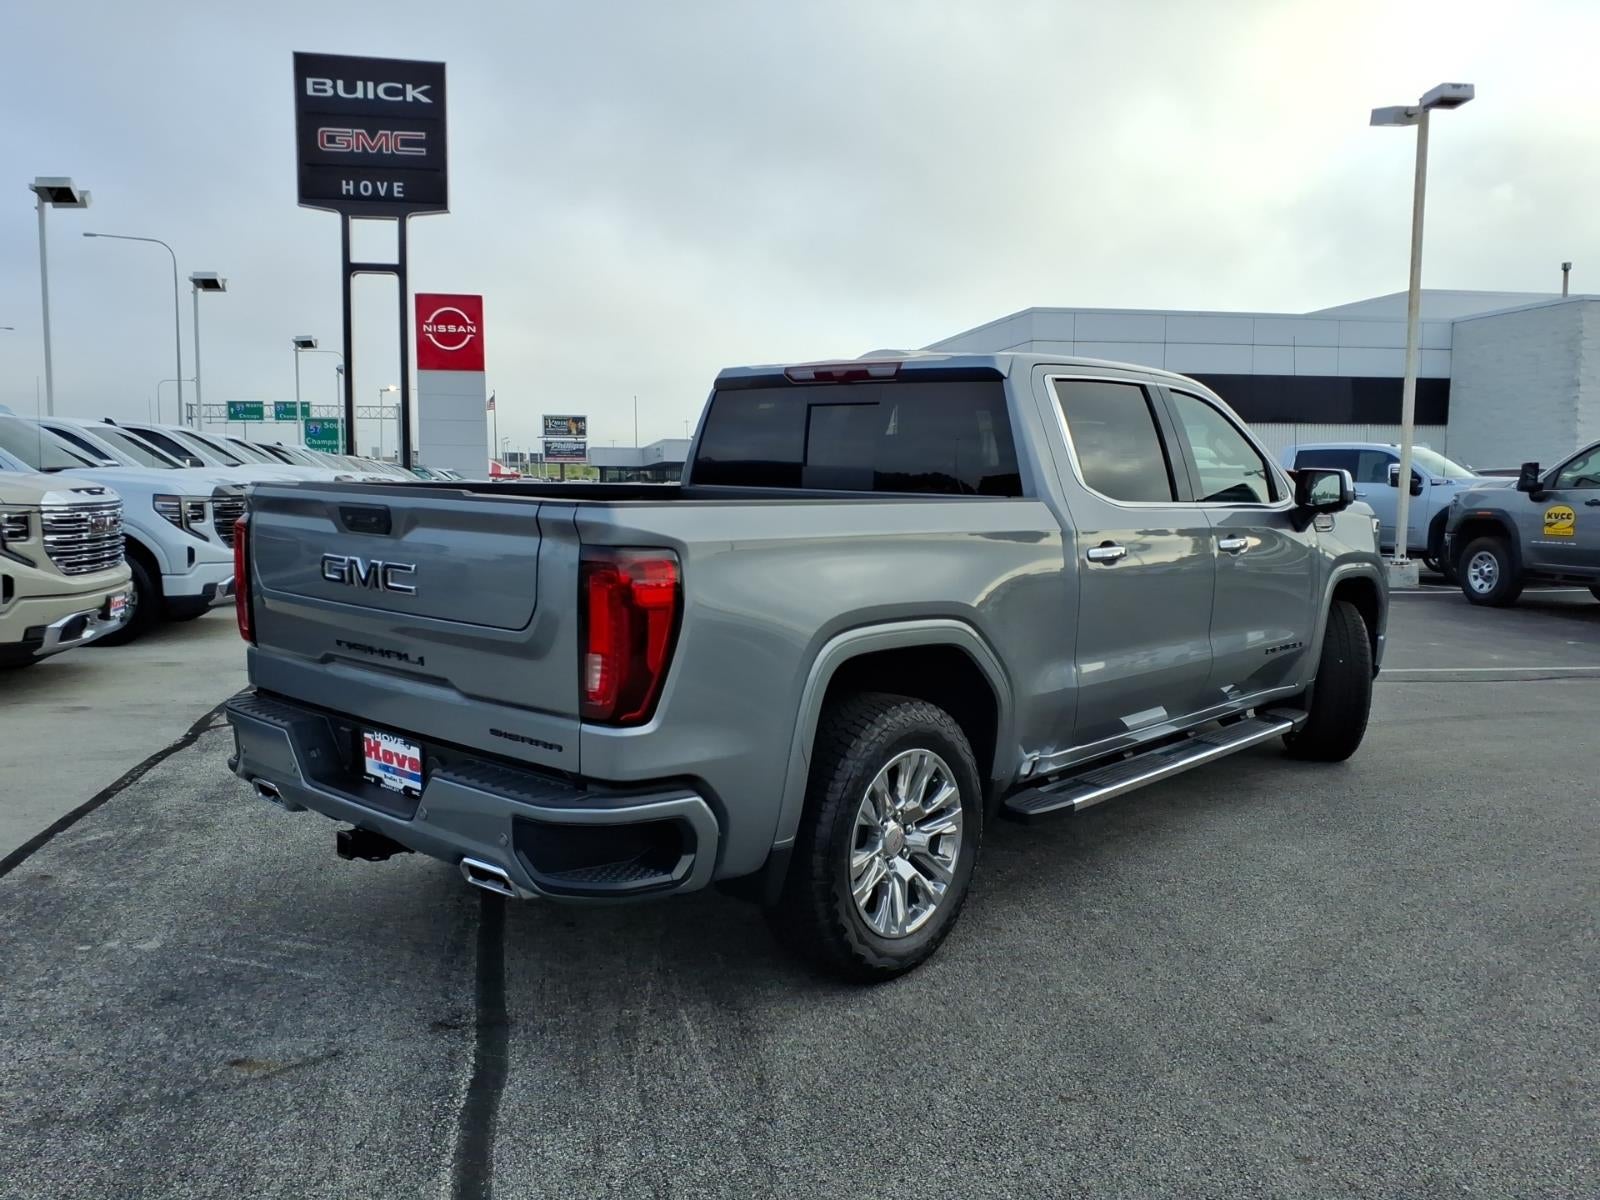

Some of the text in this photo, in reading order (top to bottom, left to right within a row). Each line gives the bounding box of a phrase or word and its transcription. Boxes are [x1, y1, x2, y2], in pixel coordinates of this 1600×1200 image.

[306, 77, 432, 103] BUICK
[317, 127, 426, 155] GMC
[341, 179, 405, 197] HOVE
[423, 323, 477, 333] NISSAN
[309, 423, 321, 433] 57
[320, 553, 417, 595] GMC
